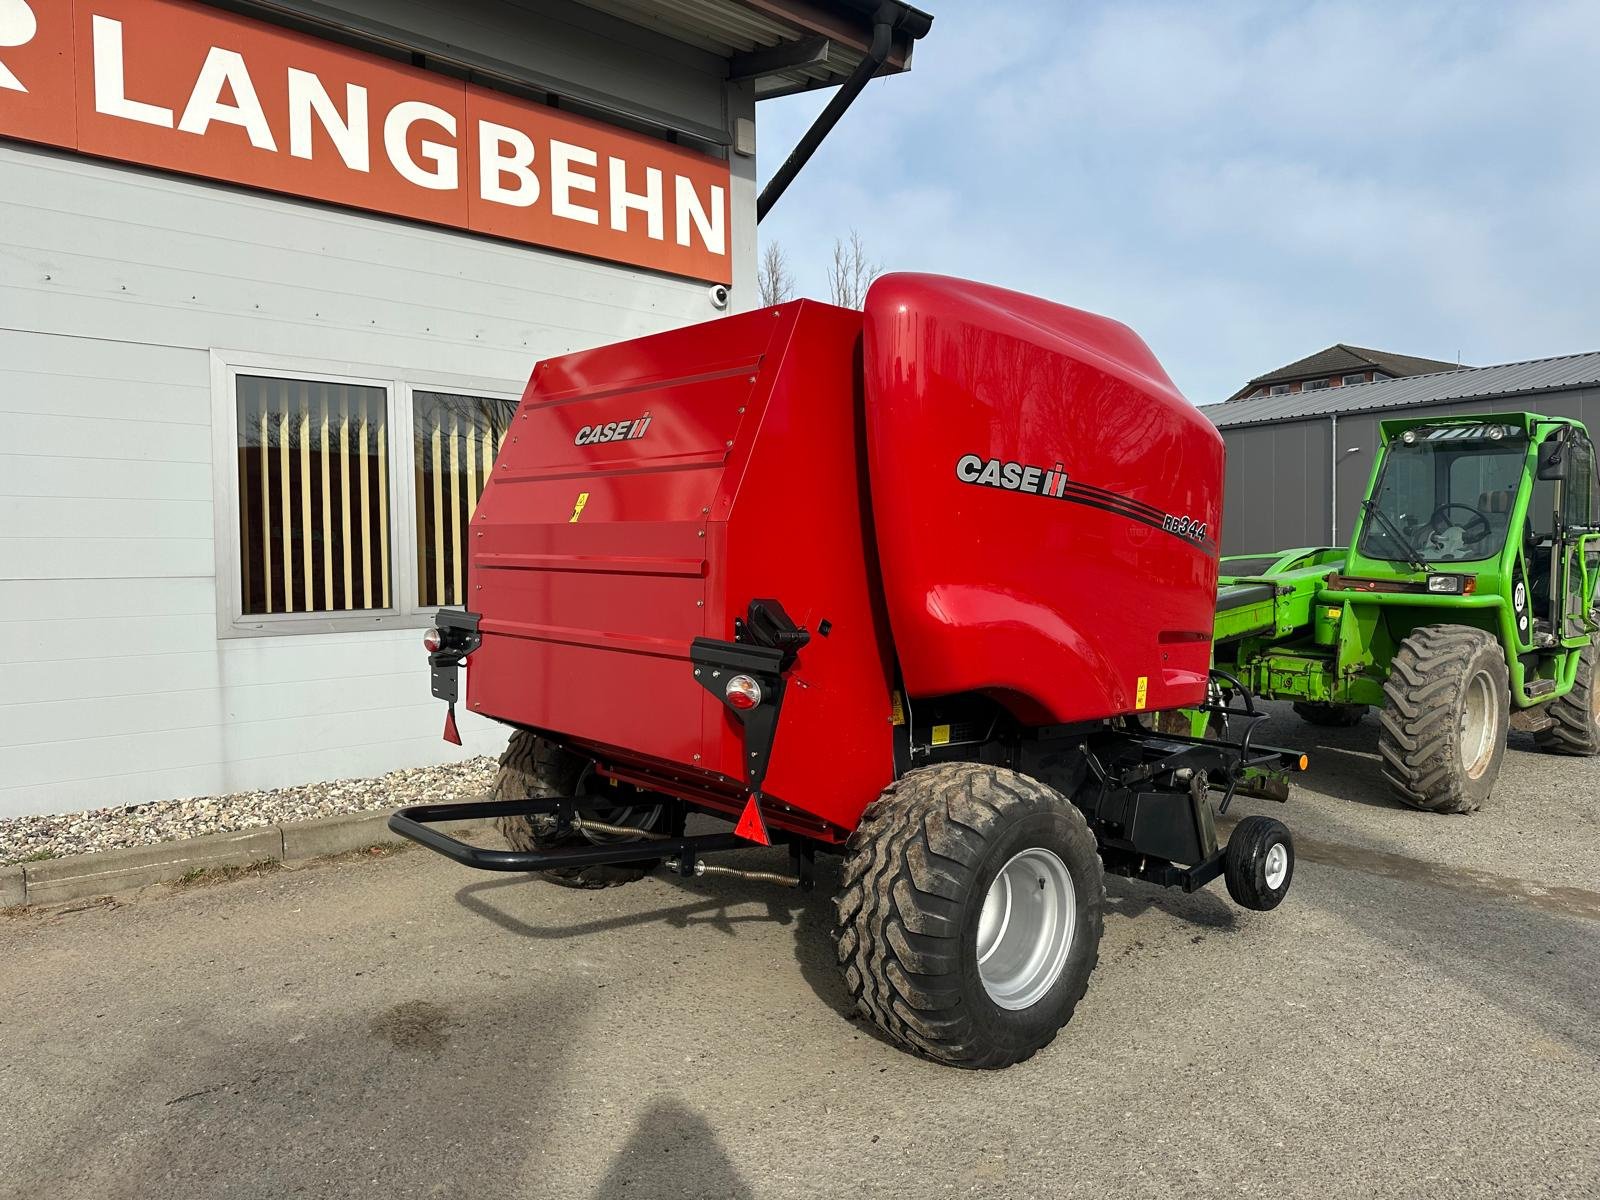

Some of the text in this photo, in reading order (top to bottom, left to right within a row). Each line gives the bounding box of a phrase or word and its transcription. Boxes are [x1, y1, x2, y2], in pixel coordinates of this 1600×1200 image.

[92, 14, 726, 256] LANGBEHN
[575, 422, 631, 446] CASE
[956, 454, 1041, 494] CASE
[1162, 513, 1207, 542] RB344
